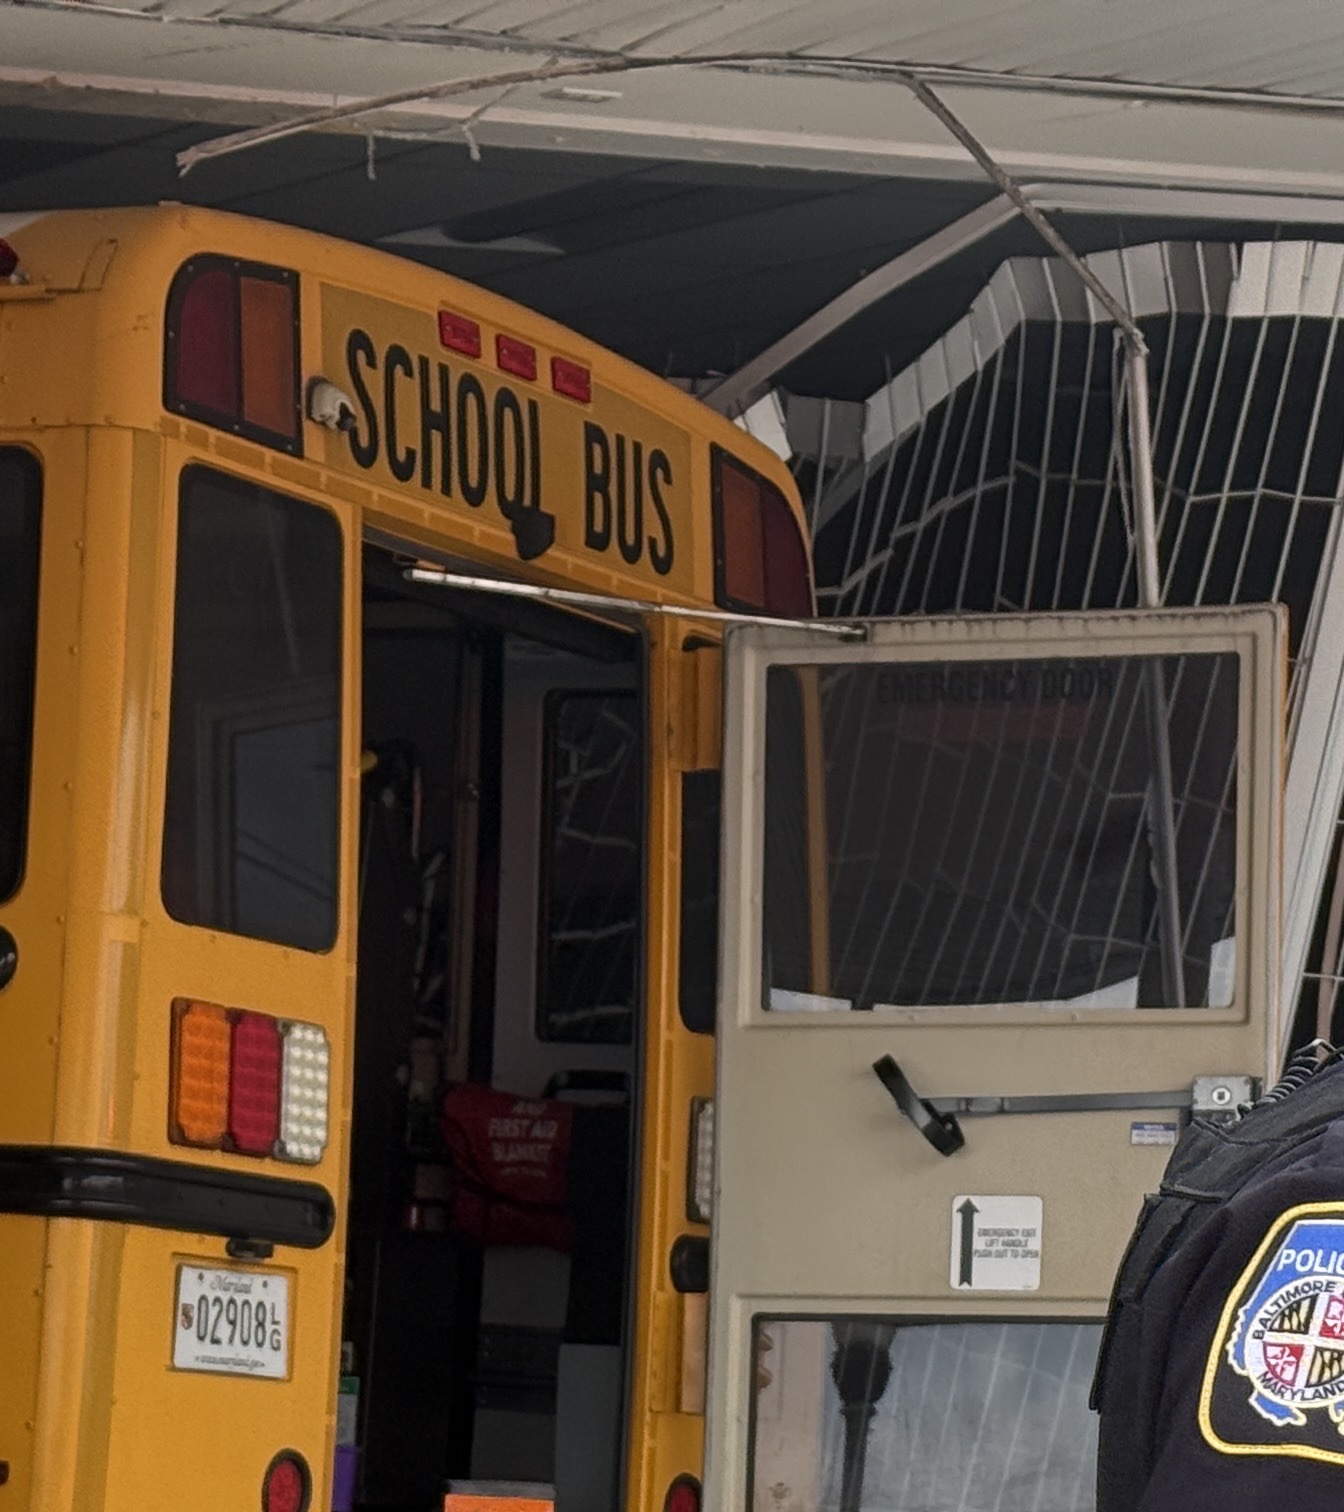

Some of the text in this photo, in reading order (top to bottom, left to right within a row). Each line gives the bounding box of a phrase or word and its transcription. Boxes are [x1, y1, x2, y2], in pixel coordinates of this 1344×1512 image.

[345, 328, 675, 576] SCHOOL BUS
[876, 666, 1115, 704] EMERGENCY DOOR
[488, 1118, 558, 1138] FIRST AID
[196, 1294, 267, 1349] 02908
[1252, 1280, 1337, 1340] BALTIMORE
